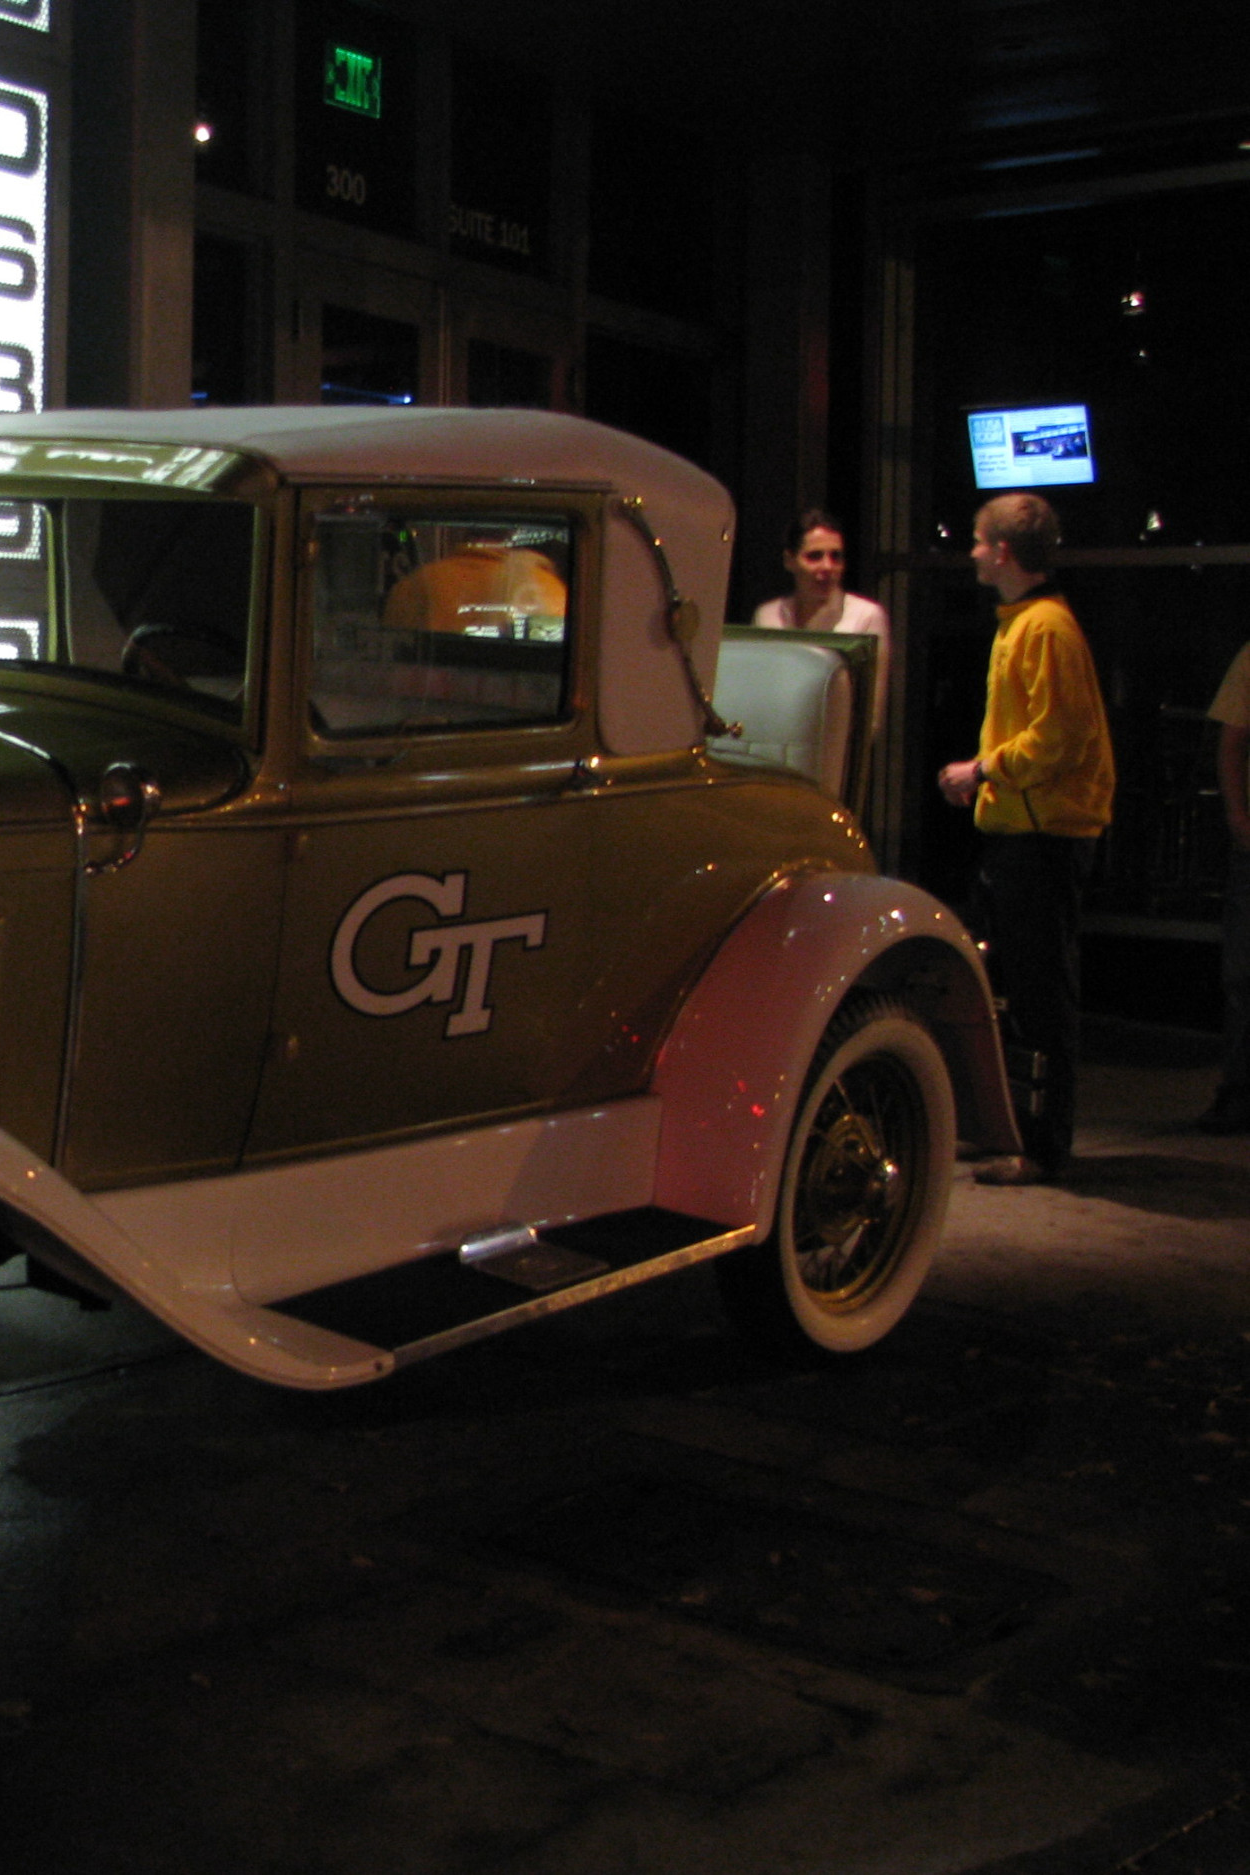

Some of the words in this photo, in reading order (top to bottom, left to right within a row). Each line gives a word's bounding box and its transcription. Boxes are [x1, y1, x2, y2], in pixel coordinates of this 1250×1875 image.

[325, 163, 367, 206] 300
[447, 200, 496, 245] SUITE
[498, 220, 531, 256] 101
[328, 869, 549, 1041] GT
